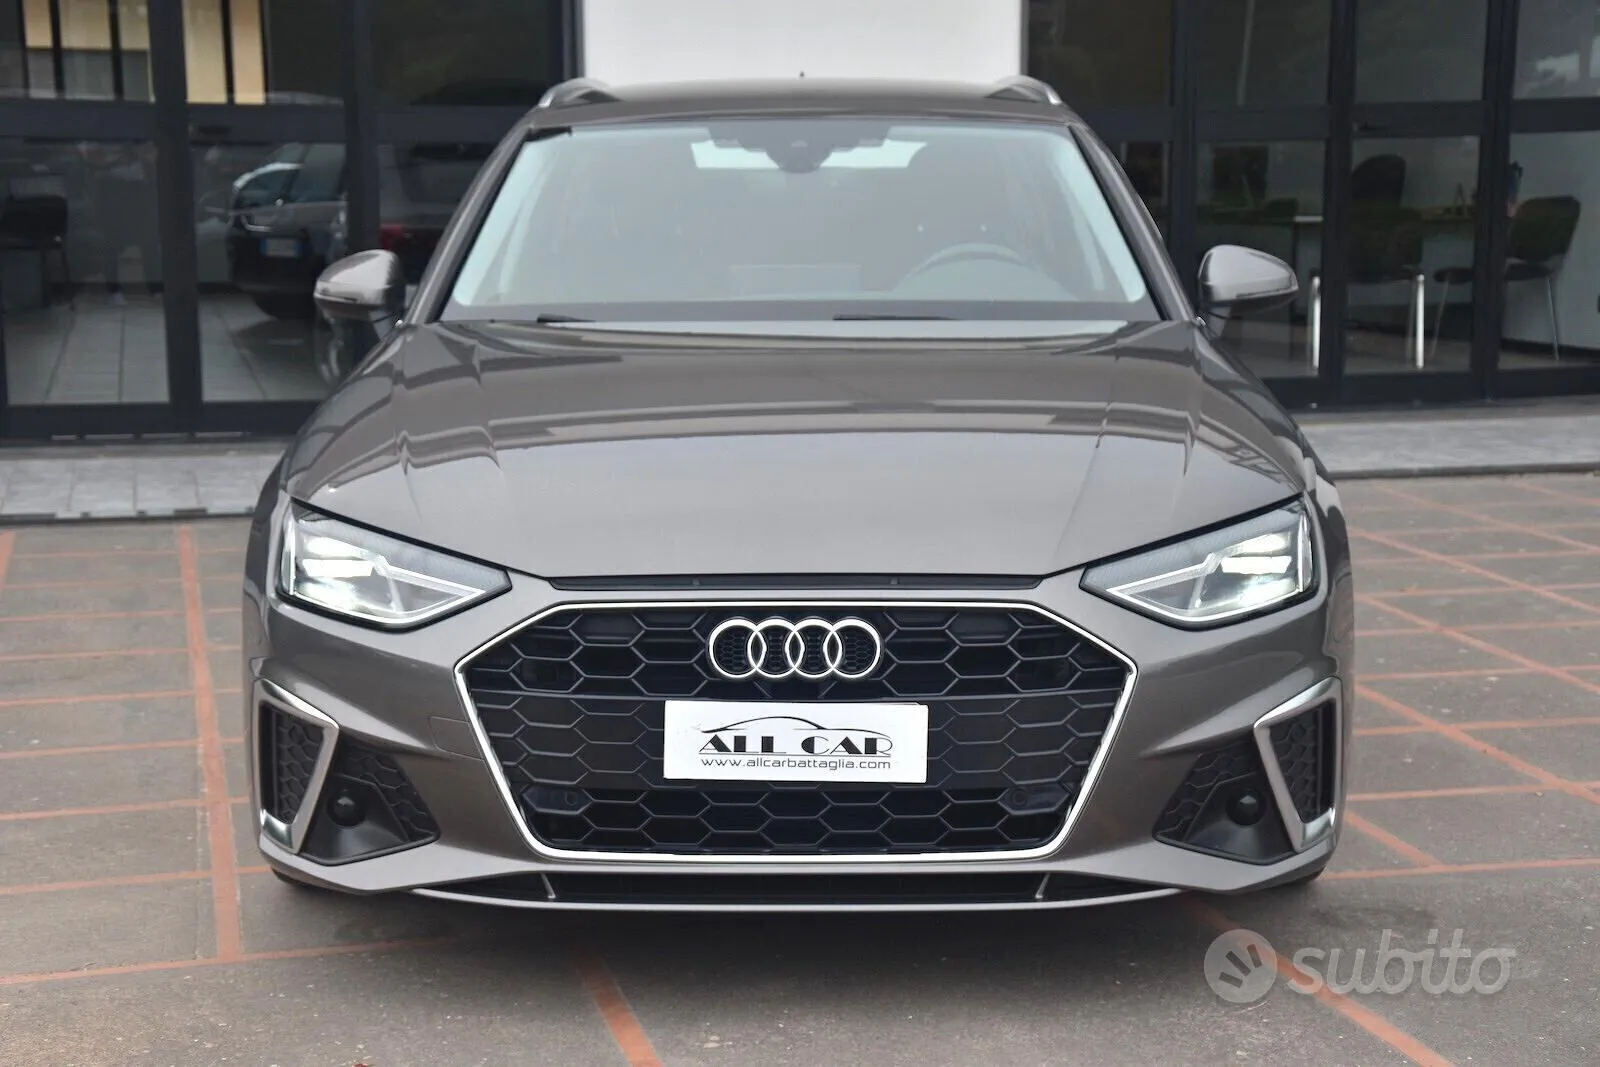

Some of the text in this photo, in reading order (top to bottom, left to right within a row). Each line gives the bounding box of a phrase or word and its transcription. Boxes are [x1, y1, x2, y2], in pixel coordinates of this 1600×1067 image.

[699, 734, 893, 756] ALL CAR
[701, 757, 891, 771] www.allcarbattaglia.com
